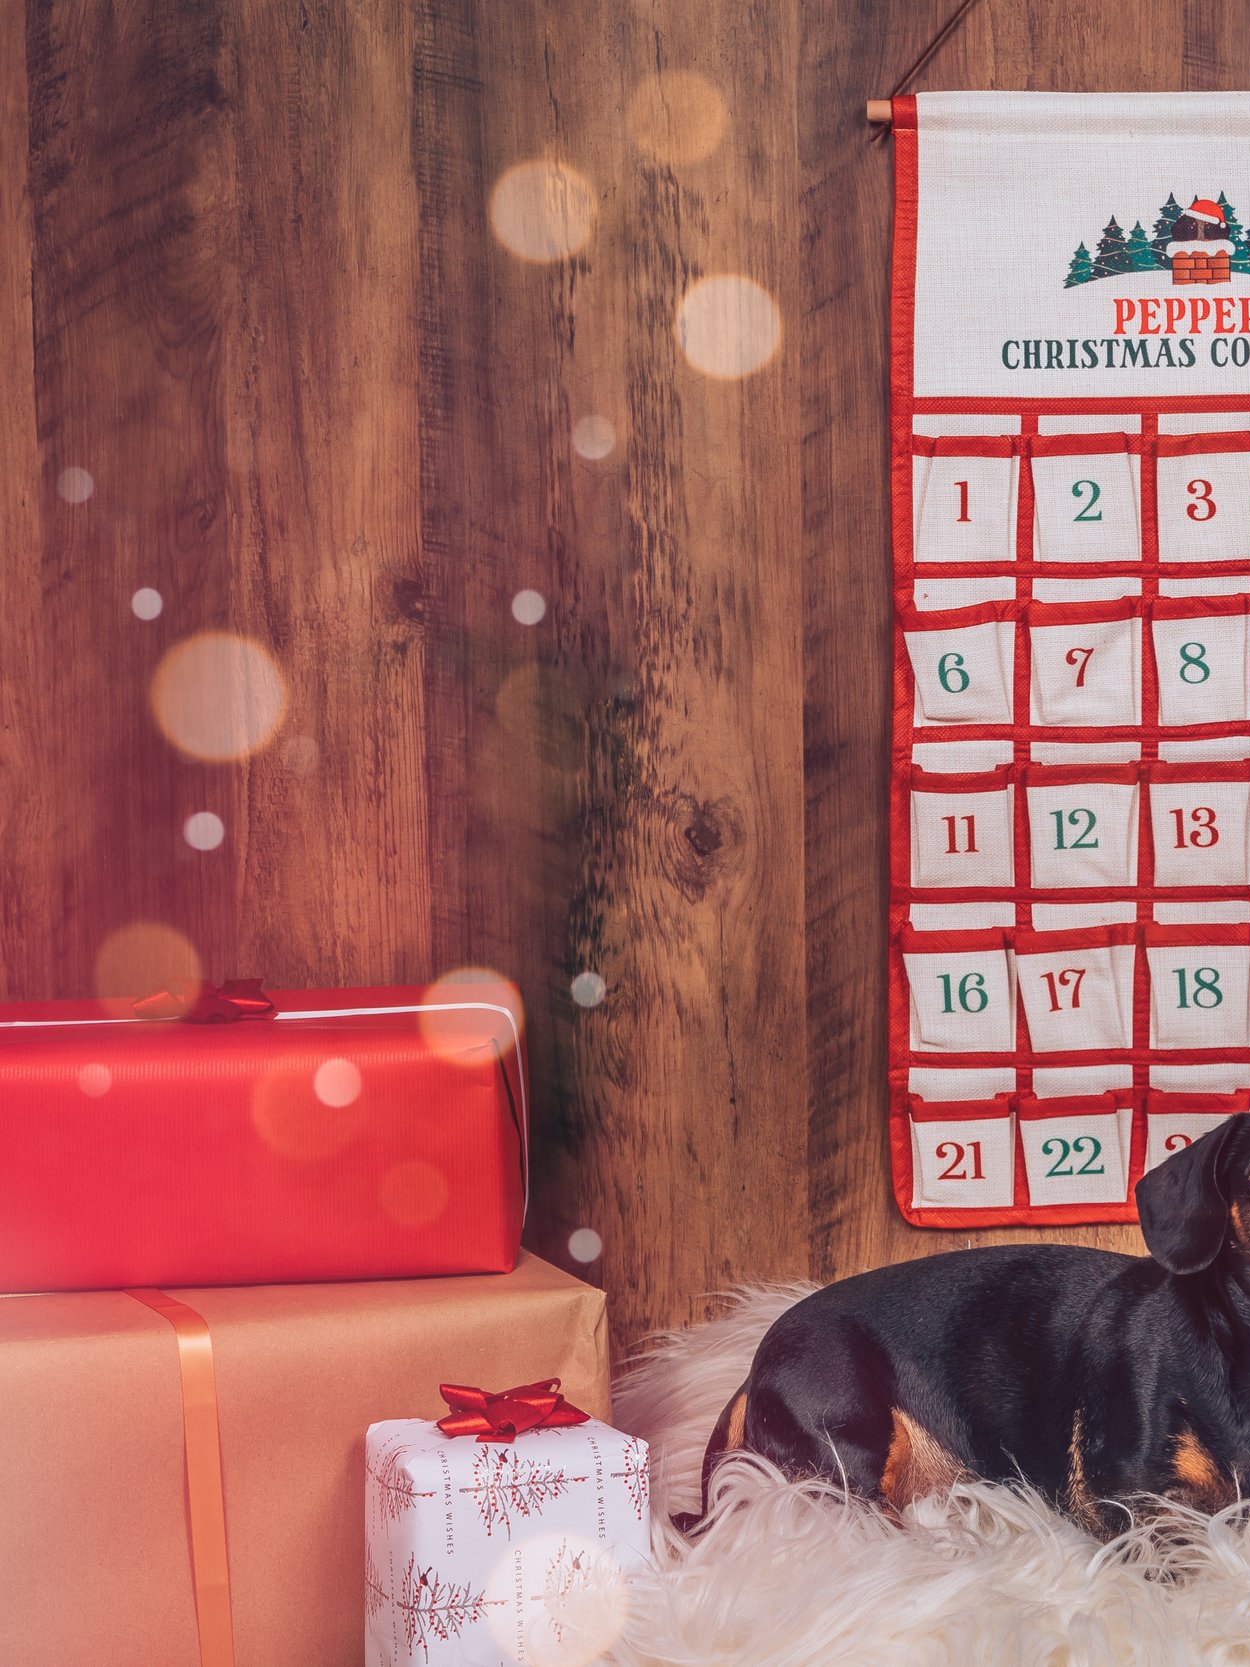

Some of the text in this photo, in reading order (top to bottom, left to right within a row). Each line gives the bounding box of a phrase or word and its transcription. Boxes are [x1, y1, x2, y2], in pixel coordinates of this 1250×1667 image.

[1001, 337, 1197, 370] CHRISTMAS
[954, 480, 972, 522] 1
[1071, 480, 1103, 522] 2
[1186, 478, 1217, 522] 3
[937, 652, 970, 694] 6
[1065, 647, 1095, 688] 7
[1179, 642, 1211, 684] 8
[941, 814, 980, 854] 11
[1049, 808, 1099, 850] 12
[1169, 807, 1220, 849] 13
[936, 972, 989, 1014] 16
[1040, 968, 1086, 1013] 17
[1172, 967, 1223, 1009] 18
[935, 1141, 986, 1181] 21
[1042, 1136, 1105, 1178] 22
[437, 1450, 454, 1555] CHRISTMAS WISHES
[588, 1436, 606, 1539] CHRISTMAS WISHES
[514, 1549, 525, 1663] CHRISTMAS WISHES
